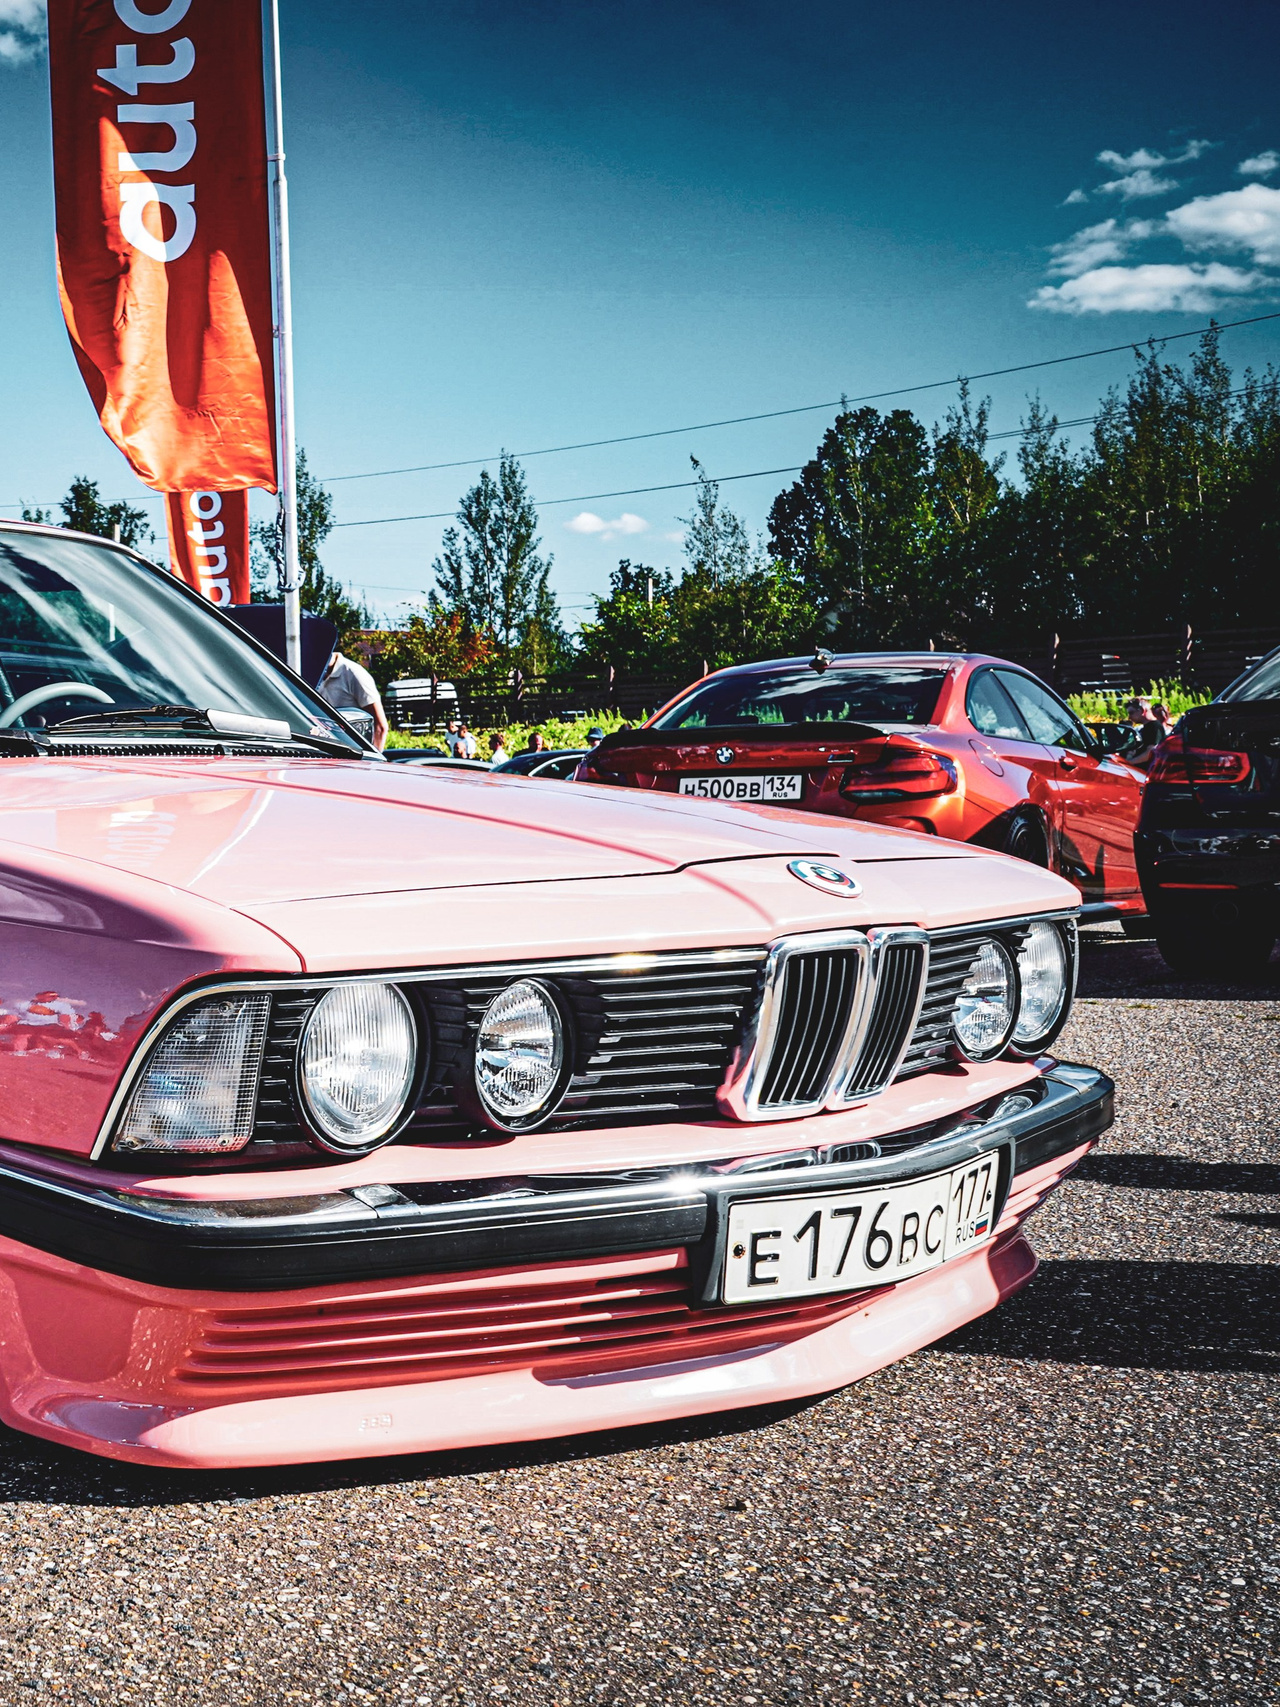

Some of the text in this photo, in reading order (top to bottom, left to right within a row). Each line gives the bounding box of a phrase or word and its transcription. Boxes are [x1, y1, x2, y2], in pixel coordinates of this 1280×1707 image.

[187, 491, 232, 608] auto
[766, 776, 796, 792] 134
[747, 1161, 992, 1287] E176BC 177
[955, 1220, 976, 1246] RUS
